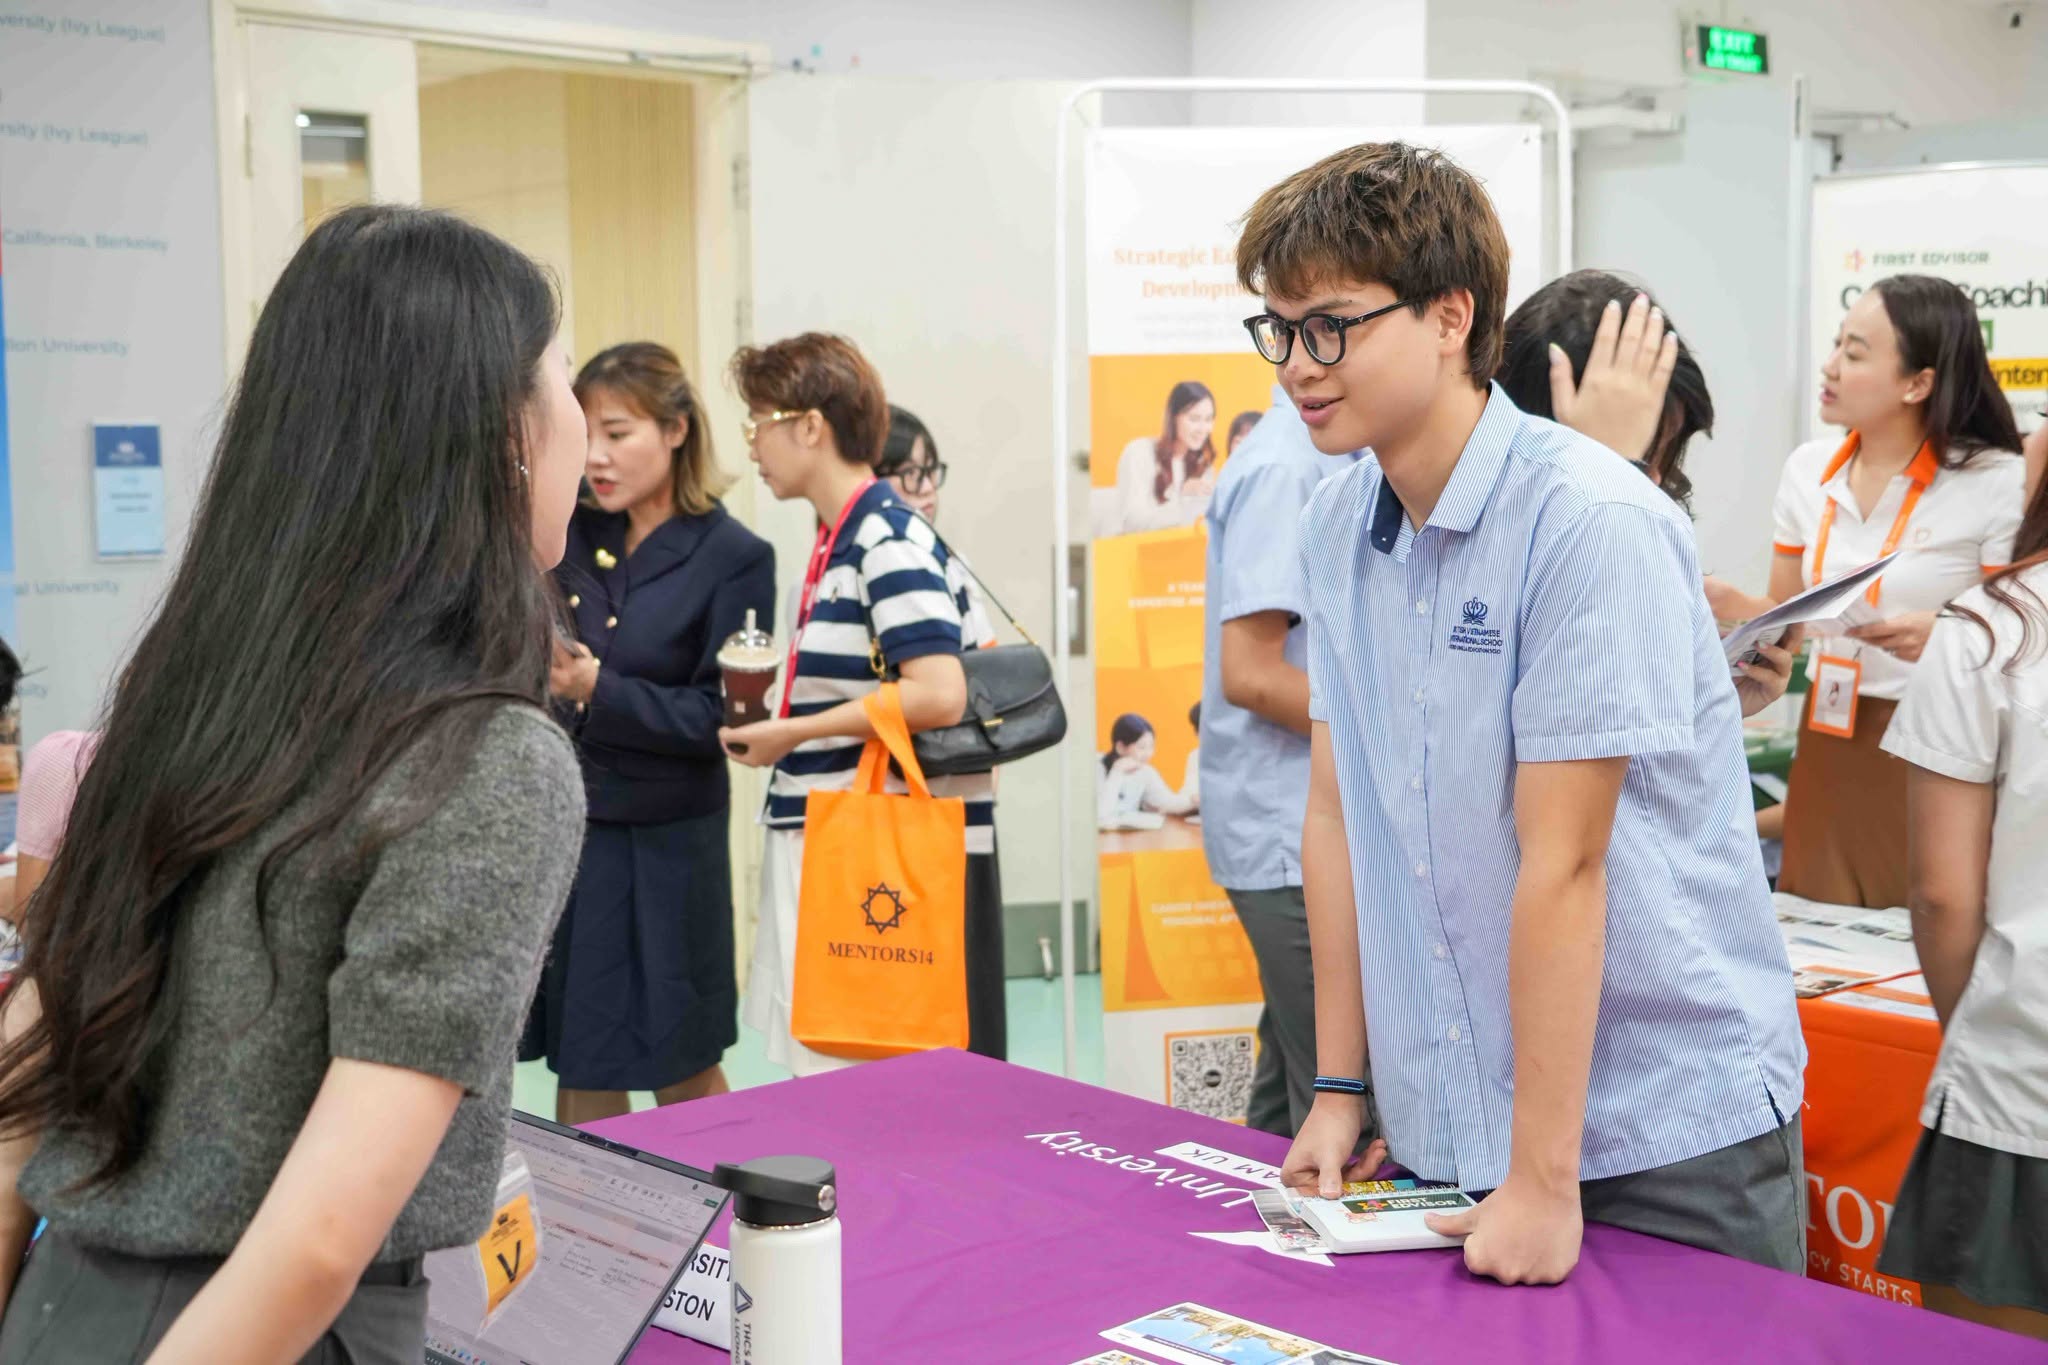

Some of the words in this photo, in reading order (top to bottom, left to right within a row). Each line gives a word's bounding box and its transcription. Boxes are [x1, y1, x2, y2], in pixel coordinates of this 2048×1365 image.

[1113, 246, 1207, 269] Strategic
[1872, 252, 1915, 265] FIRST
[1921, 252, 1989, 265] EDVISOR
[827, 942, 934, 965] MENTORS14
[1182, 1149, 1229, 1164] UK
[1024, 1131, 1251, 1208] University
[497, 1240, 520, 1283] V
[1838, 1263, 1913, 1306] STARTS
